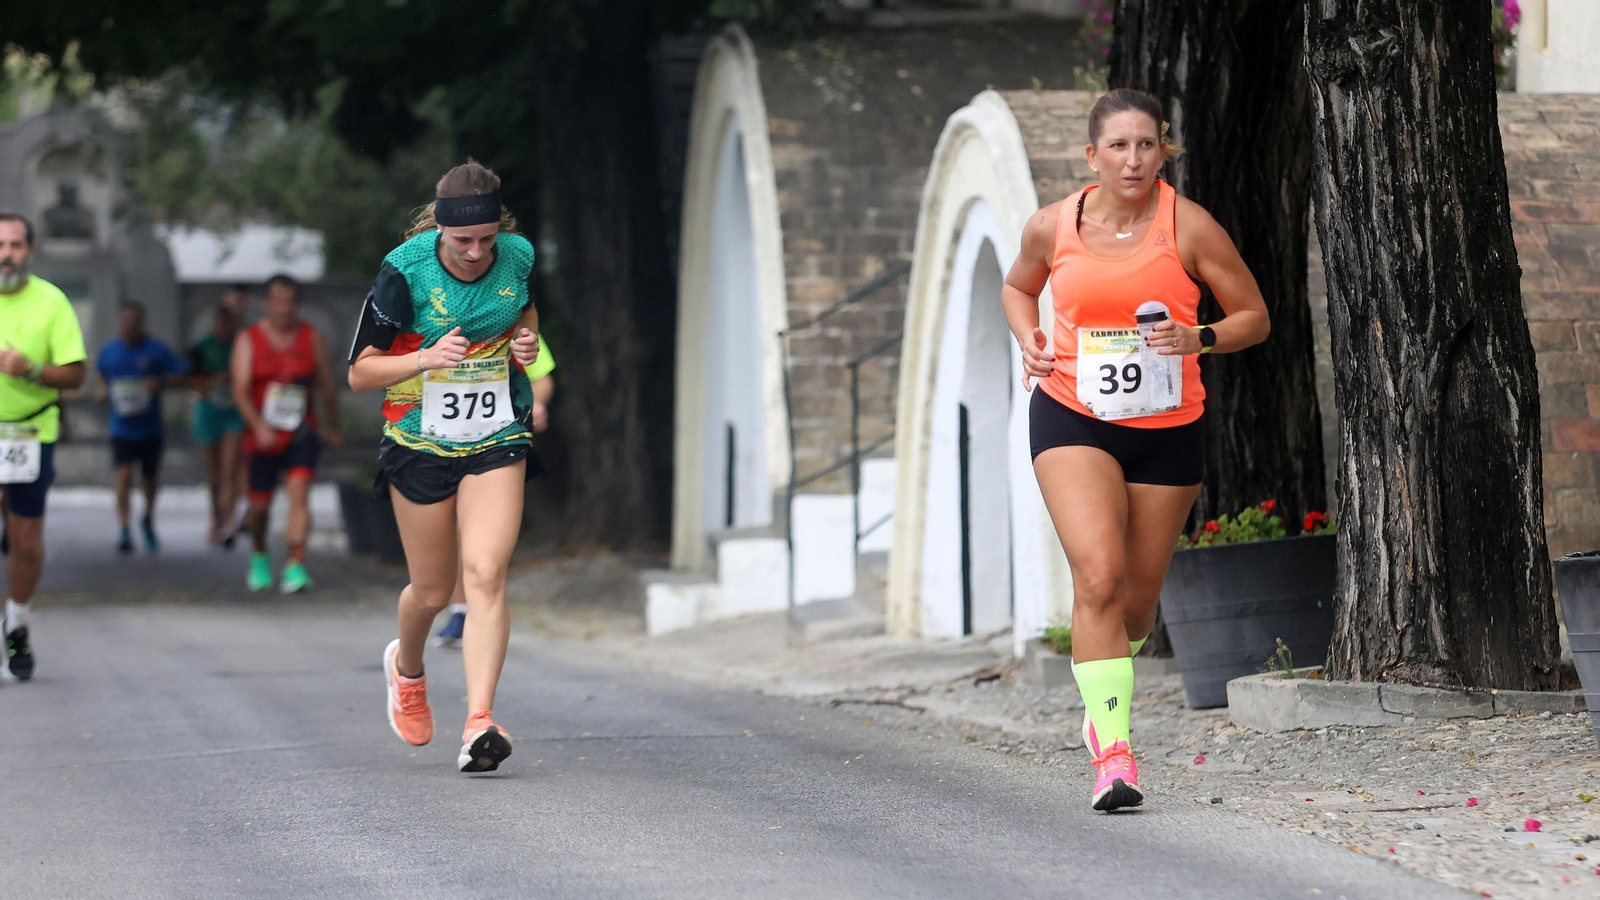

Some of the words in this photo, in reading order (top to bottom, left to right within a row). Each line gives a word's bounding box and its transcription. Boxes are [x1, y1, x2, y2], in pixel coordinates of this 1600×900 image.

[1090, 330, 1129, 338] CARRERA
[1099, 362, 1142, 395] 39
[442, 390, 496, 420] 379
[0, 444, 29, 467] 45
